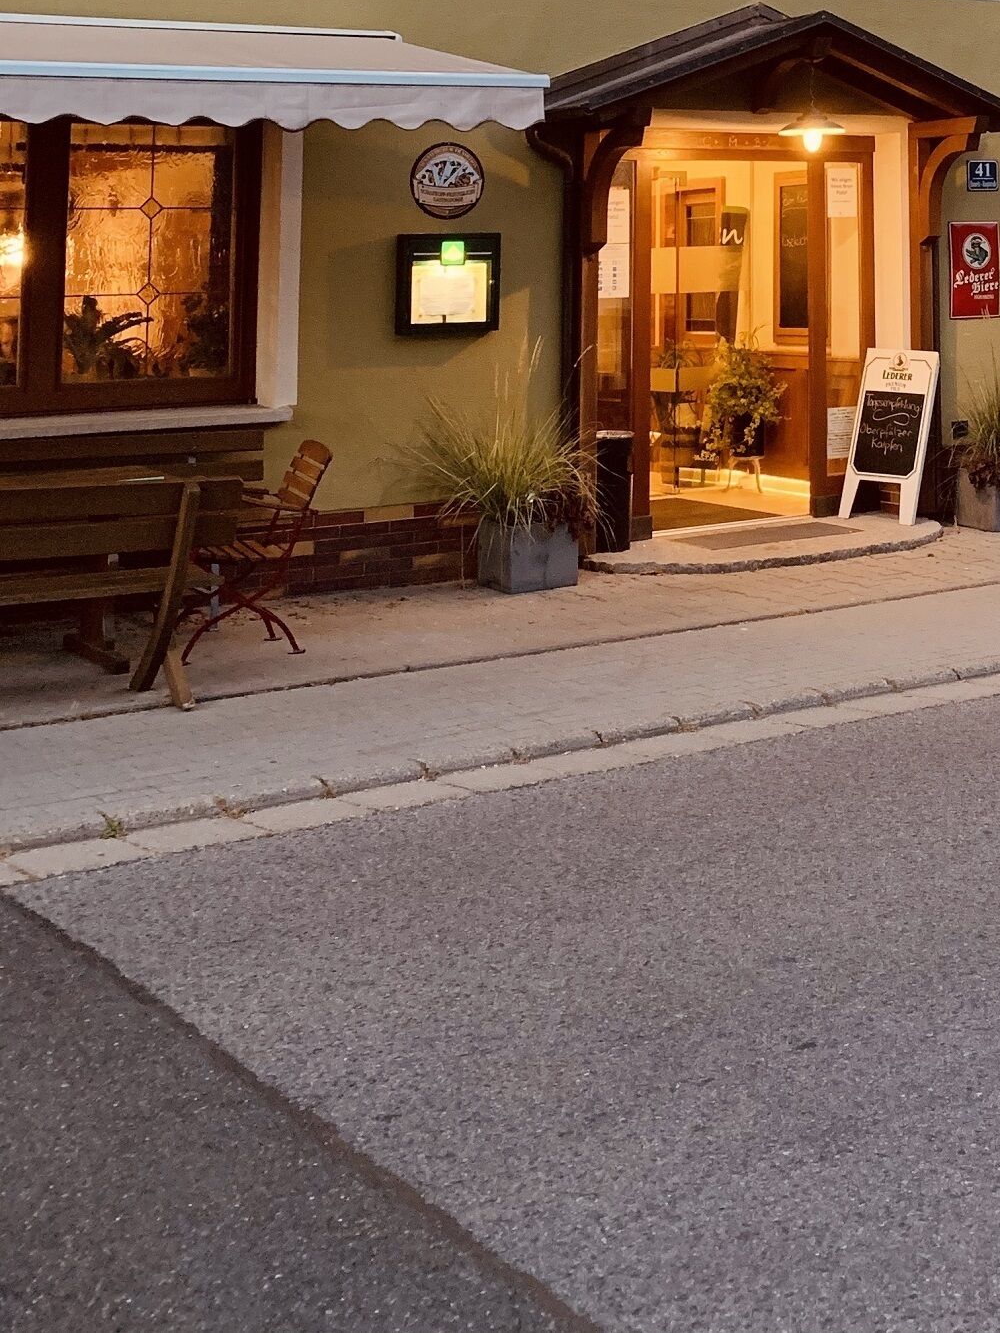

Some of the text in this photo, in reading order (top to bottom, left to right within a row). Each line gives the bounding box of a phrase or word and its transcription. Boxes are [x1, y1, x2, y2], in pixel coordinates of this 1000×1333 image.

[975, 162, 991, 177] 41
[953, 267, 995, 288] Lederer
[971, 280, 999, 296] Biere
[882, 369, 913, 381] LEDERER
